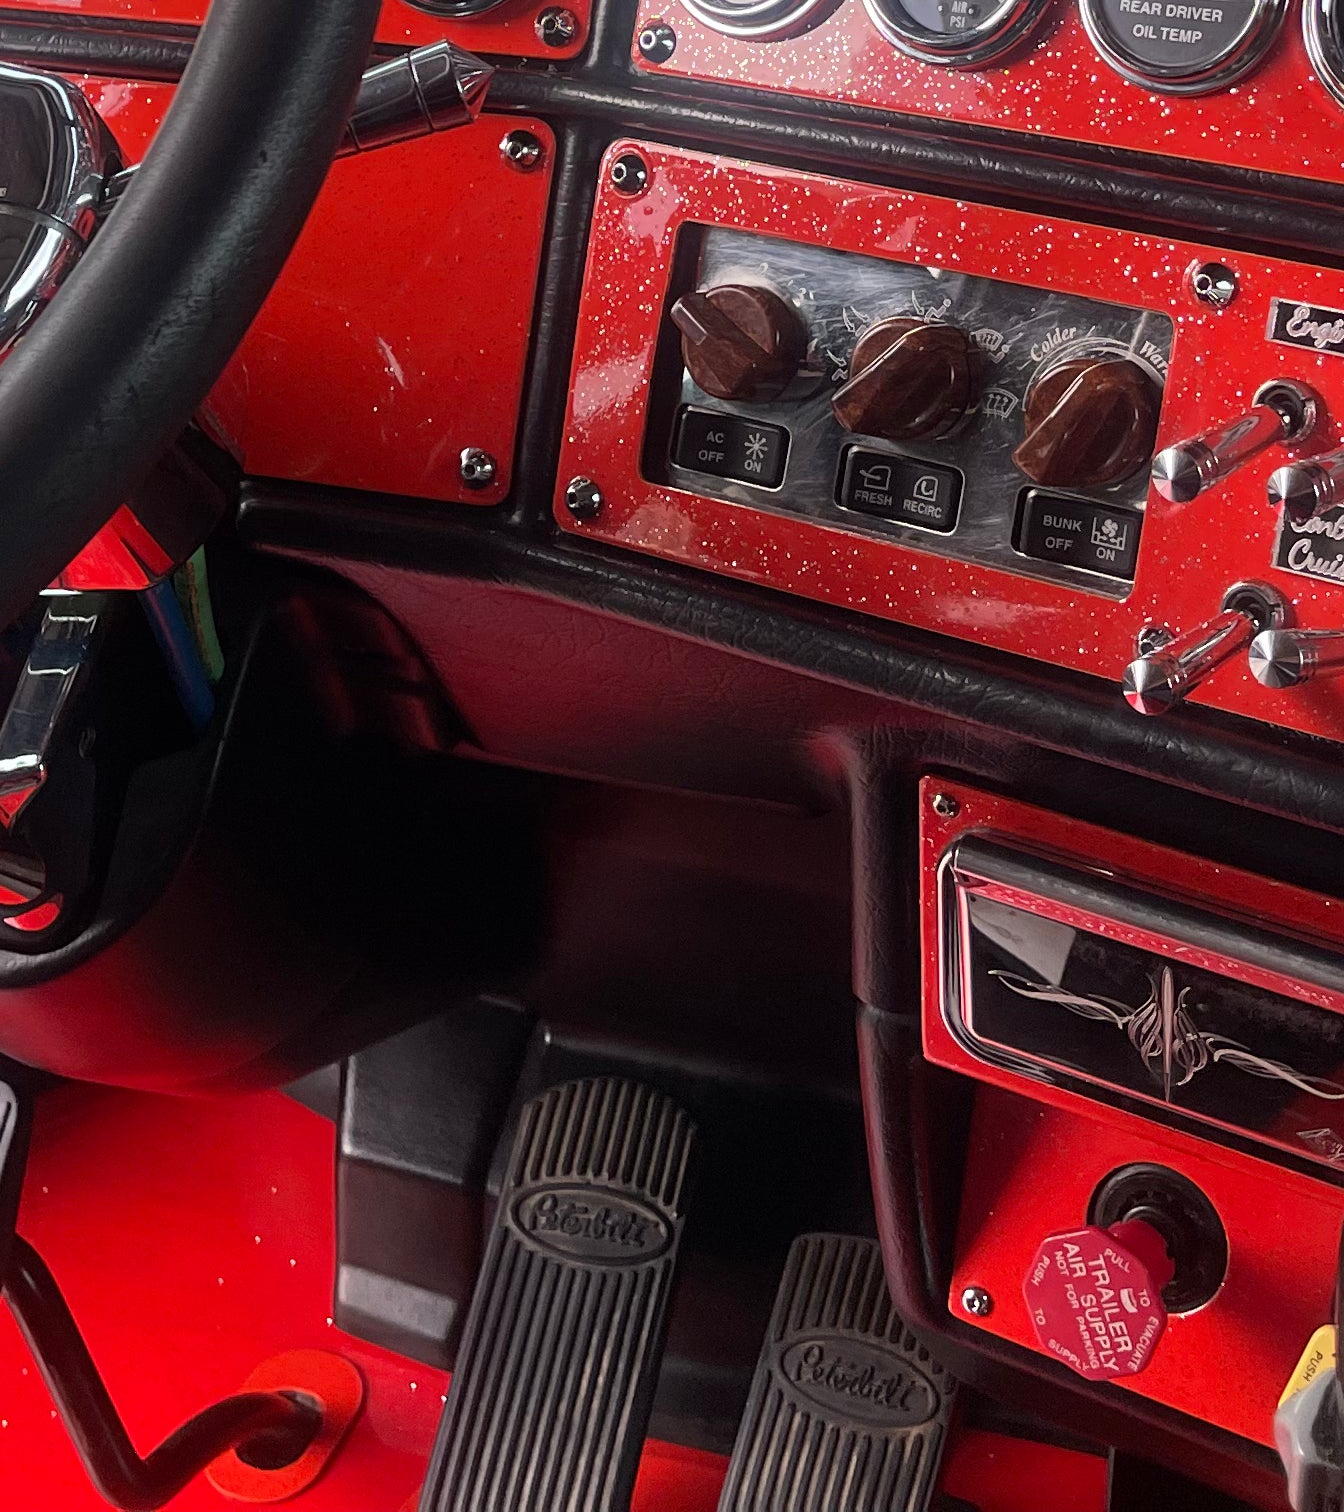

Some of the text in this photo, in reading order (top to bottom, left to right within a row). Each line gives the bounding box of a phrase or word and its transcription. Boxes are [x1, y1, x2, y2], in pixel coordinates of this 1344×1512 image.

[952, 1, 967, 13] AIR
[1120, 0, 1222, 22] REAR DRIVER
[950, 16, 965, 28] PSI
[1132, 24, 1202, 44] OIL TEMP
[1030, 326, 1077, 362] Colder
[1139, 341, 1169, 378] War
[706, 431, 724, 443] AC
[698, 450, 725, 463] OFF
[744, 460, 762, 473] ON
[854, 490, 892, 506] FRESH
[903, 499, 942, 518] RECIRC
[1043, 514, 1083, 532] BUNK
[1045, 537, 1074, 550] OFF
[1096, 547, 1115, 561] ON
[1031, 1255, 1089, 1371] PUSH TO SUPPLY
[1054, 1251, 1100, 1369] NOT FOR PARKING
[1063, 1243, 1120, 1371] AIR SUPPLY
[1088, 1254, 1132, 1353] TRAILER
[1103, 1248, 1159, 1372] PULL TO EVACUATE
[1303, 1350, 1323, 1382] PUSH
